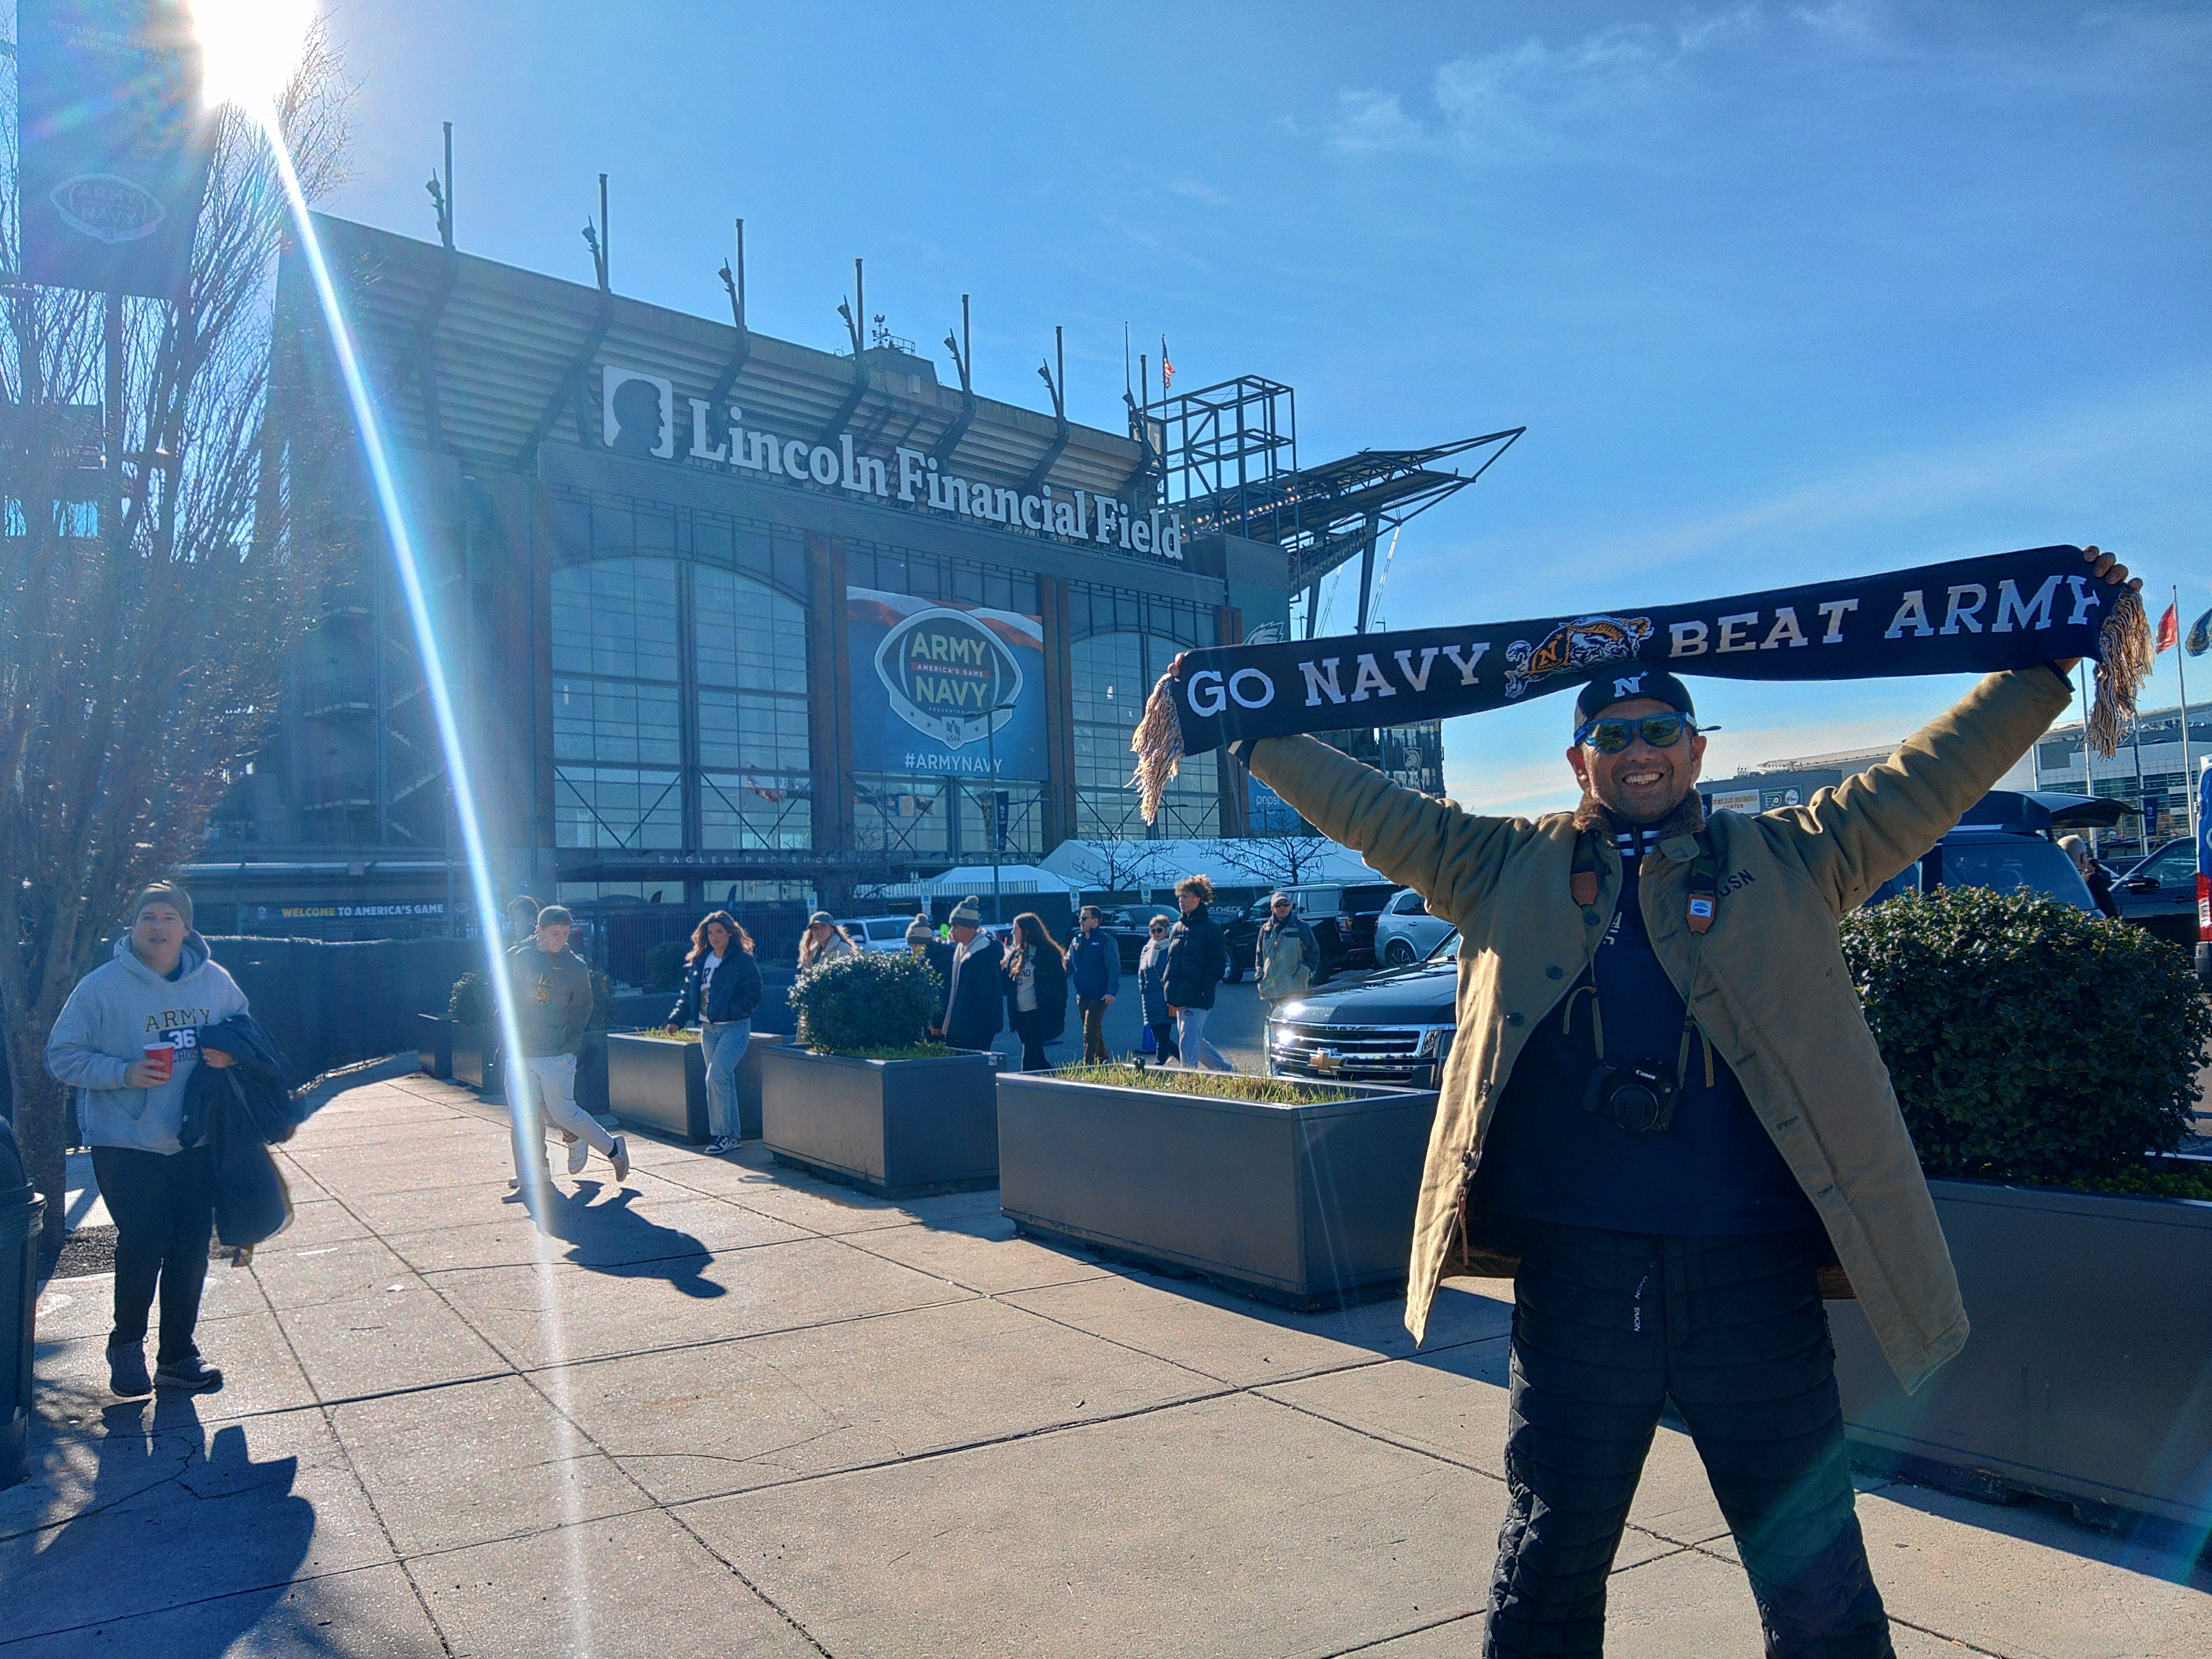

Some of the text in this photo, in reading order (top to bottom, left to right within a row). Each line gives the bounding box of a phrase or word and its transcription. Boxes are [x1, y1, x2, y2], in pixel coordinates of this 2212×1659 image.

[688, 397, 1184, 561] Lincoln Financial Field
[910, 631, 986, 666] ARMY
[1187, 575, 2100, 717] GO NAVY BEAT ARMY
[917, 664, 984, 678] AMERICA'S GAME
[915, 676, 987, 708] NAVY
[1613, 677, 1641, 698] N
[904, 753, 1003, 774] #ARMYNAVY
[1256, 795, 1279, 807] pepsi
[282, 904, 444, 918] WELCOME TO AMERICA'S GAME
[144, 1007, 211, 1033] ARMY
[168, 1029, 196, 1050] 36
[1636, 1070, 1656, 1080] Canon
